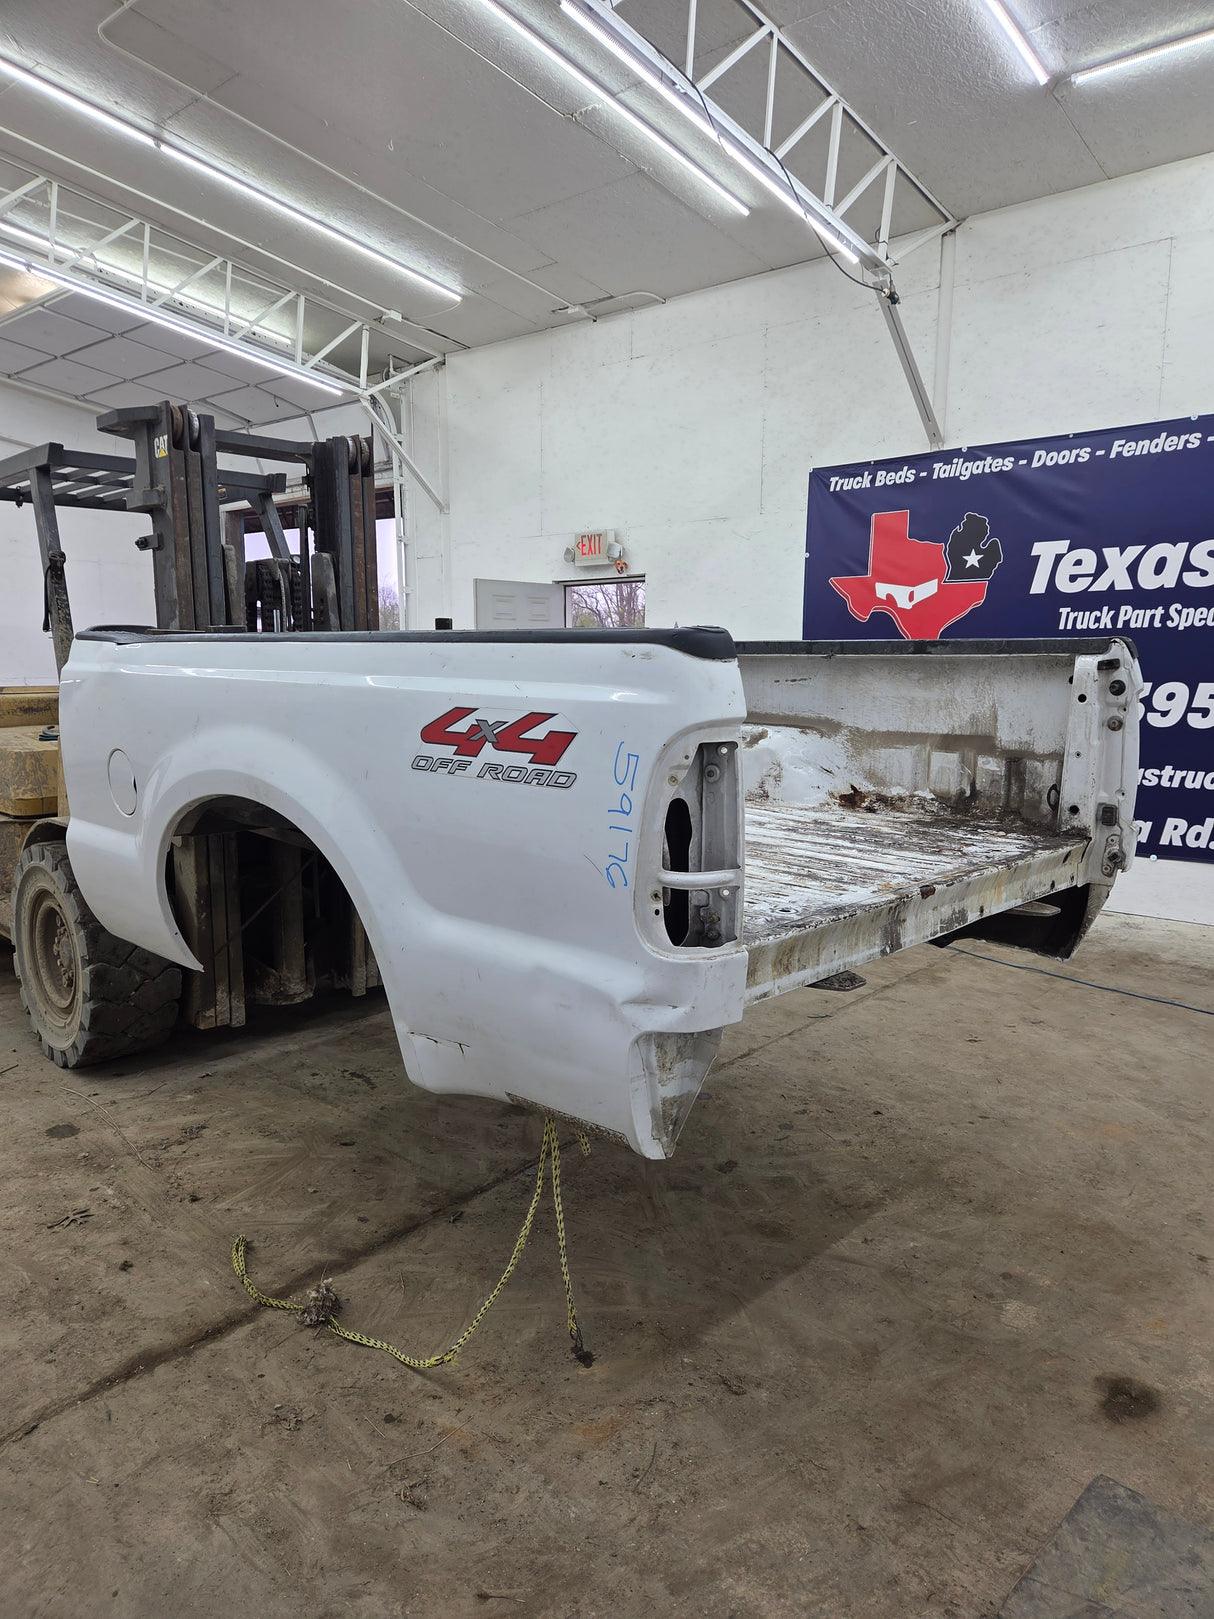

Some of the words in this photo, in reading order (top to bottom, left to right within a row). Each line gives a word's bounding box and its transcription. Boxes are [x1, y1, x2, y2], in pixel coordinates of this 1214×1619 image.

[154, 434, 168, 458] CAT
[829, 471, 873, 492] Truck
[874, 466, 916, 487] Beds
[932, 456, 1015, 481] Tailgates
[1031, 447, 1092, 468] Doors
[1109, 432, 1202, 459] Fenders
[581, 533, 602, 557] EXIT
[1029, 539, 1214, 594] Texas
[1058, 605, 1116, 630] Truck
[1117, 605, 1165, 629] Part
[411, 755, 472, 775] OFF
[477, 762, 578, 789] ROAD
[1159, 817, 1214, 851] Rd.
